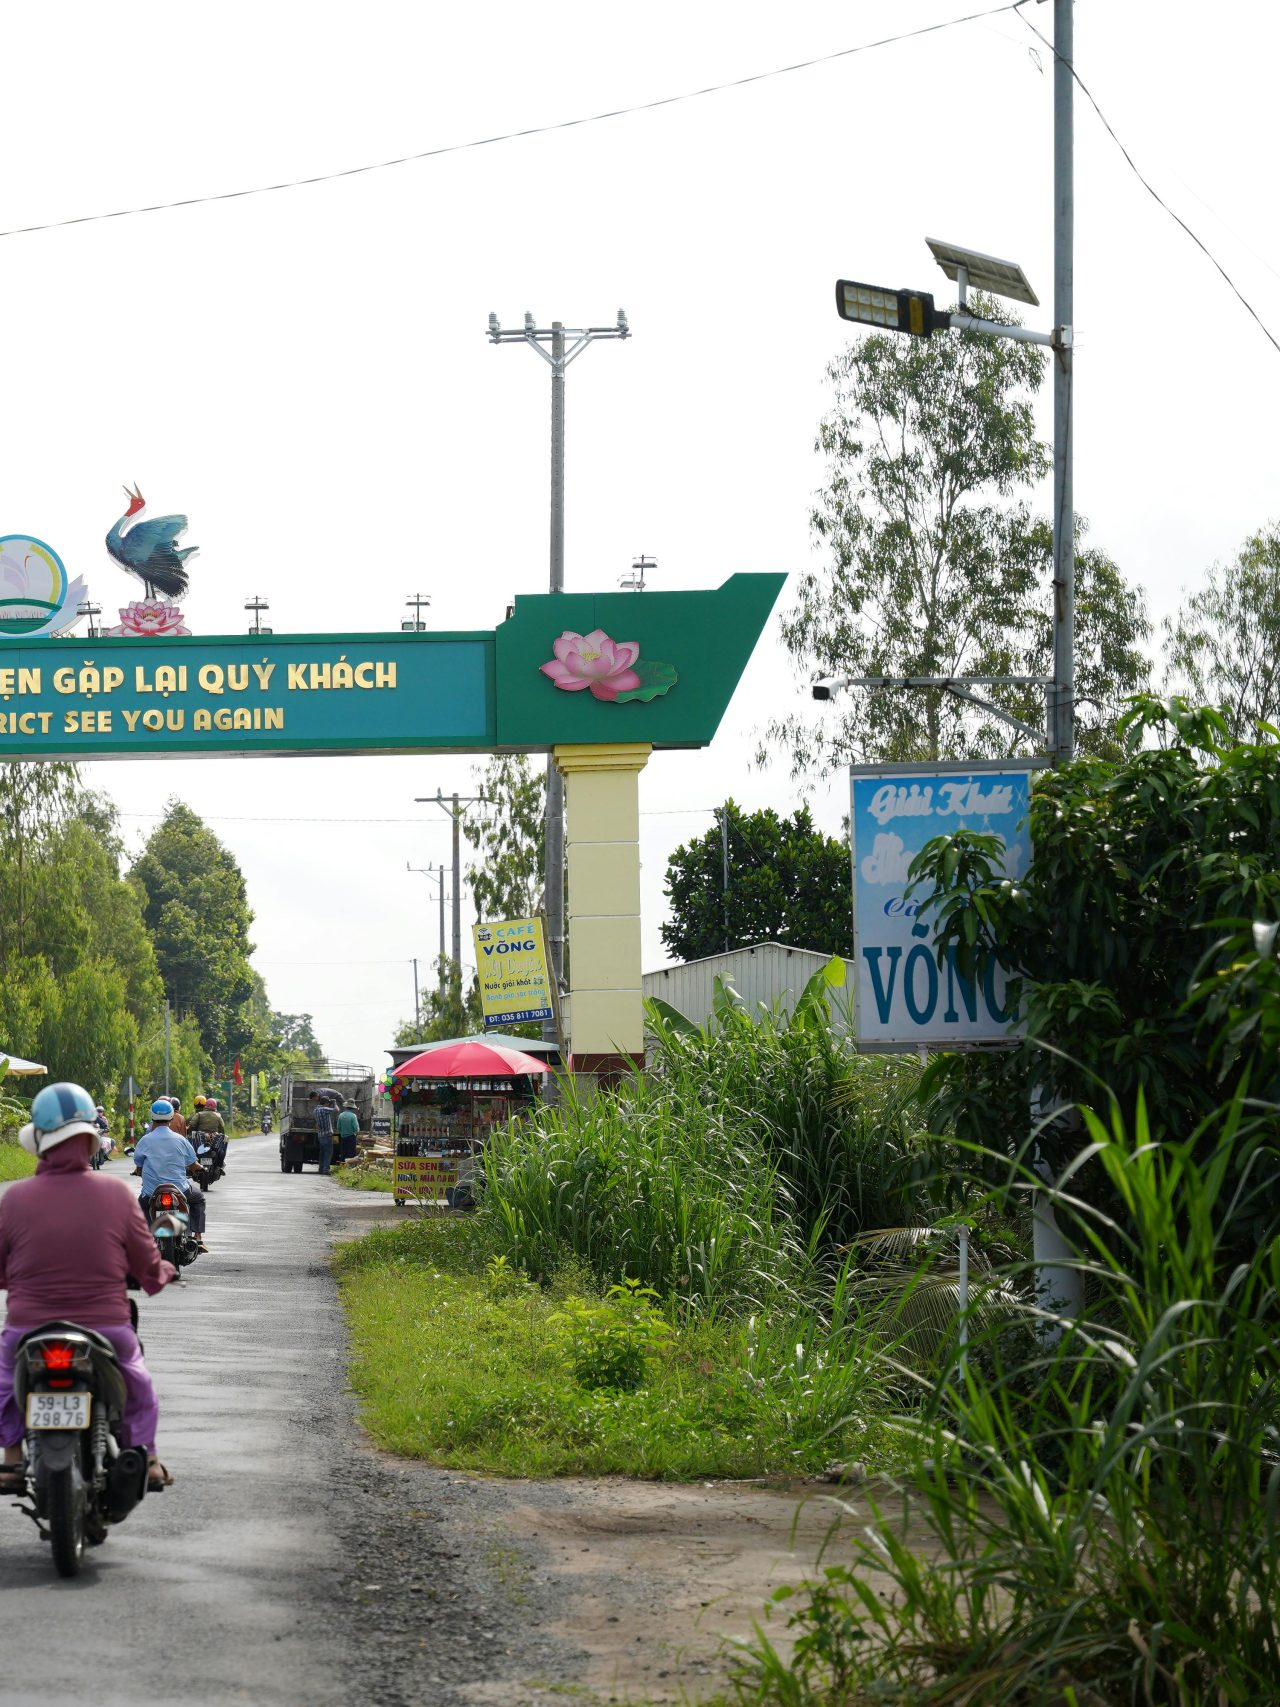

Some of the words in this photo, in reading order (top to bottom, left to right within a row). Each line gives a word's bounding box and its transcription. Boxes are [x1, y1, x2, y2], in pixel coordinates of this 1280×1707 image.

[53, 660, 125, 698] GẶP
[135, 665, 188, 698] LẠI
[198, 657, 276, 695] QUÝ
[287, 655, 397, 691] KHÁCH
[64, 710, 113, 734] SEE
[122, 709, 186, 733] YOU
[193, 707, 285, 731] AGAIN
[496, 922, 534, 937] CAFÉ
[483, 940, 536, 956] VÕNG
[531, 1009, 548, 1017] 7081
[419, 1162, 438, 1170] SEN
[37, 1396, 81, 1410] 59-L3
[32, 1412, 84, 1426] 298.76
